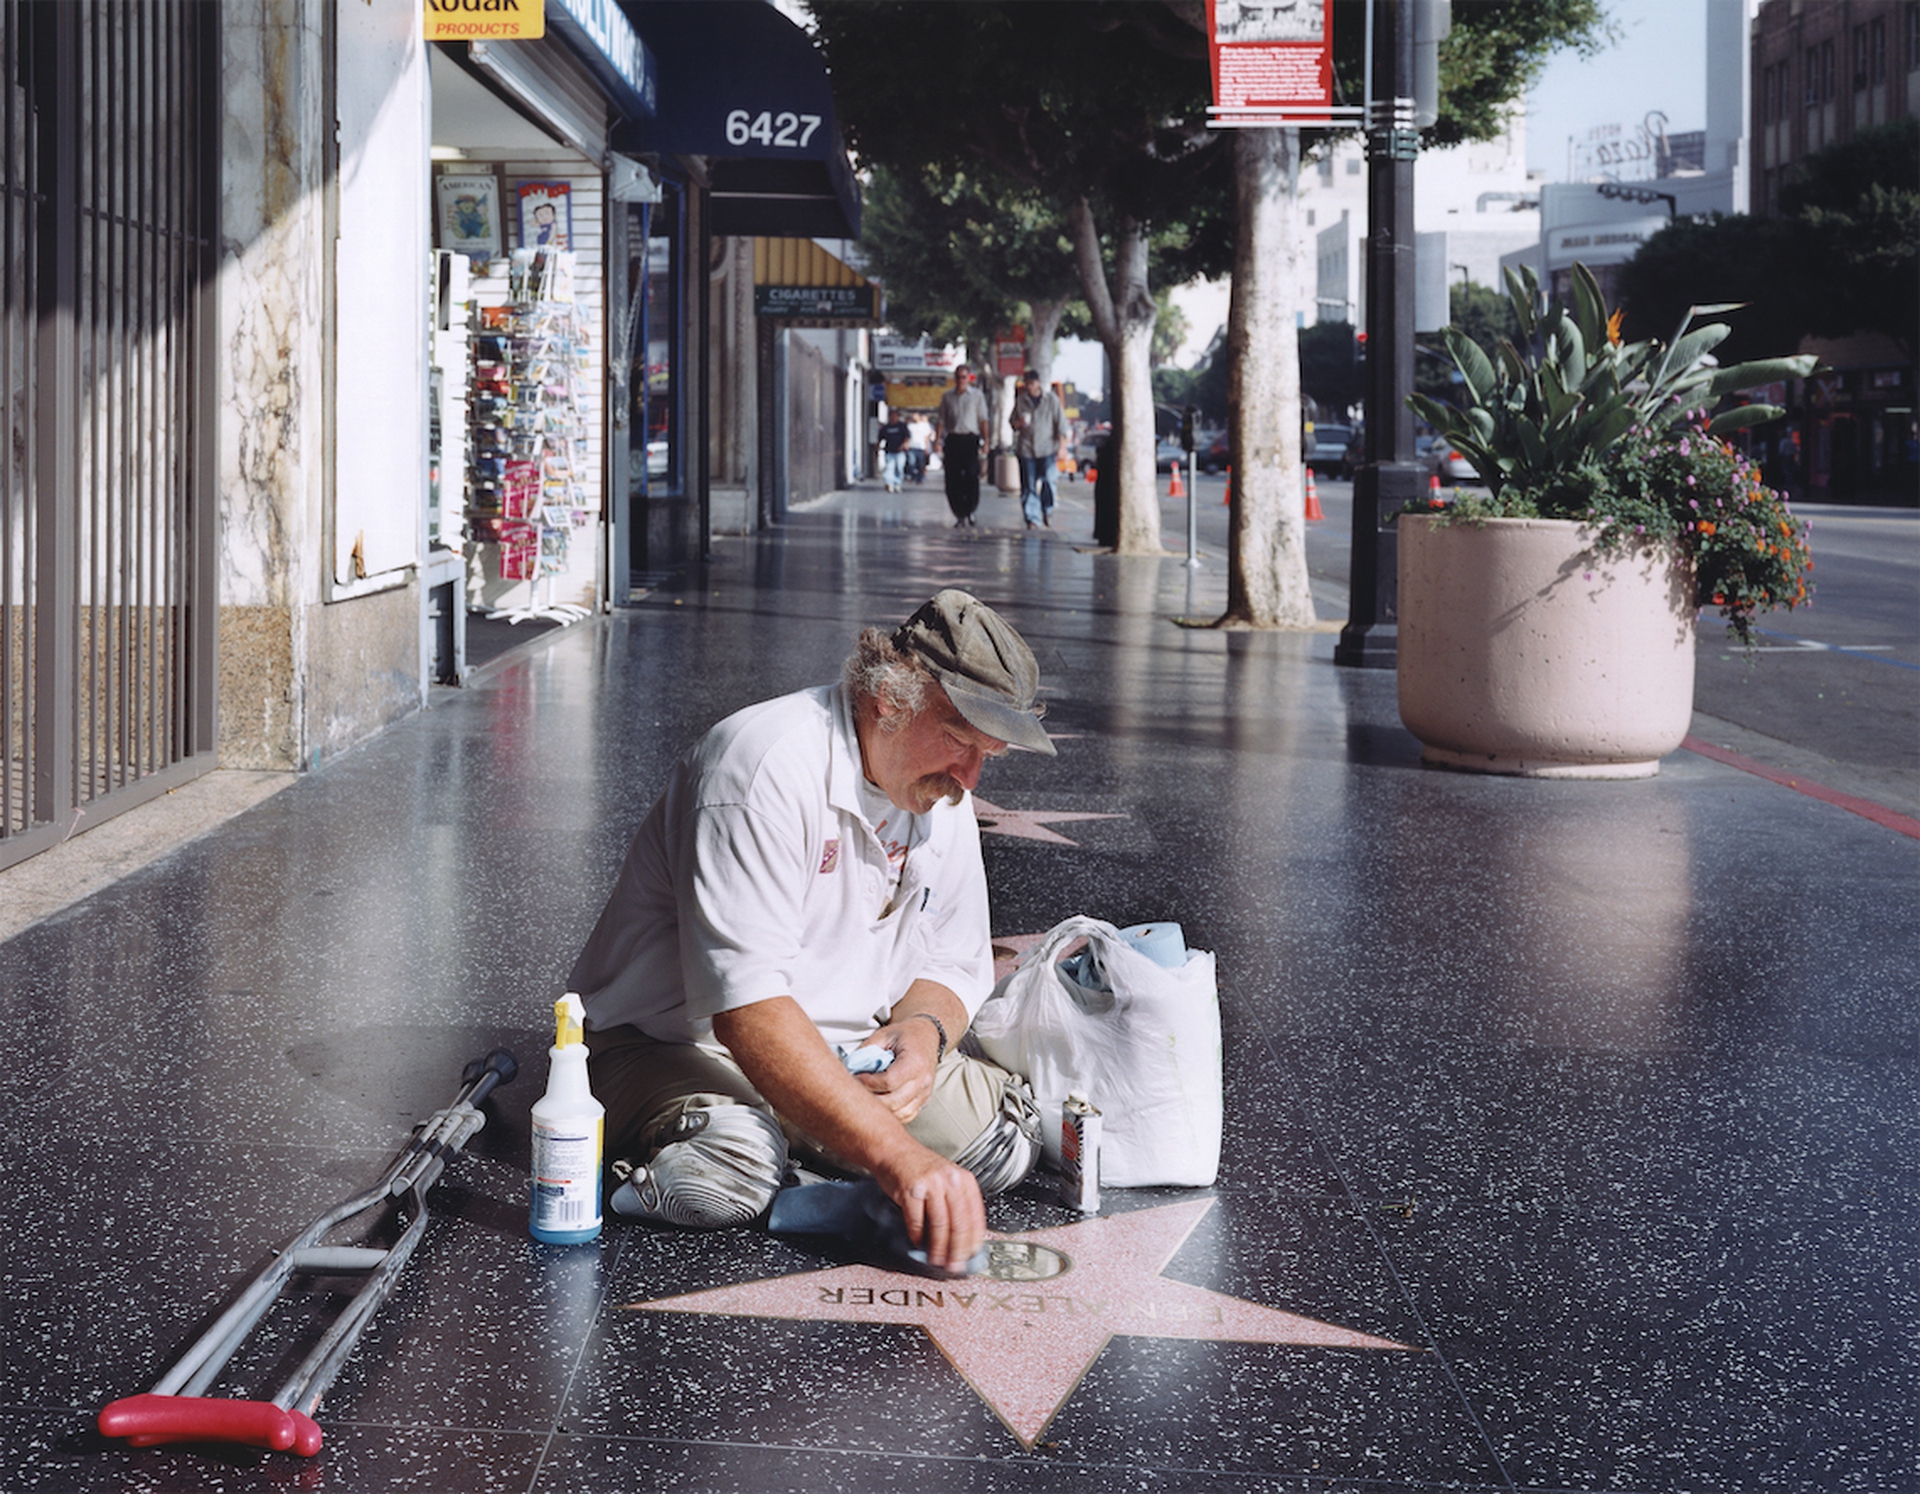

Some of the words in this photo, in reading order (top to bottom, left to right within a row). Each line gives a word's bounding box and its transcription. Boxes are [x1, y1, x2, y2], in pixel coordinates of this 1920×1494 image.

[436, 23, 520, 35] PRODUCTS
[725, 109, 821, 147] 6427
[769, 288, 856, 300] CIGARETTES
[818, 1287, 1109, 1318] ALEXANDER
